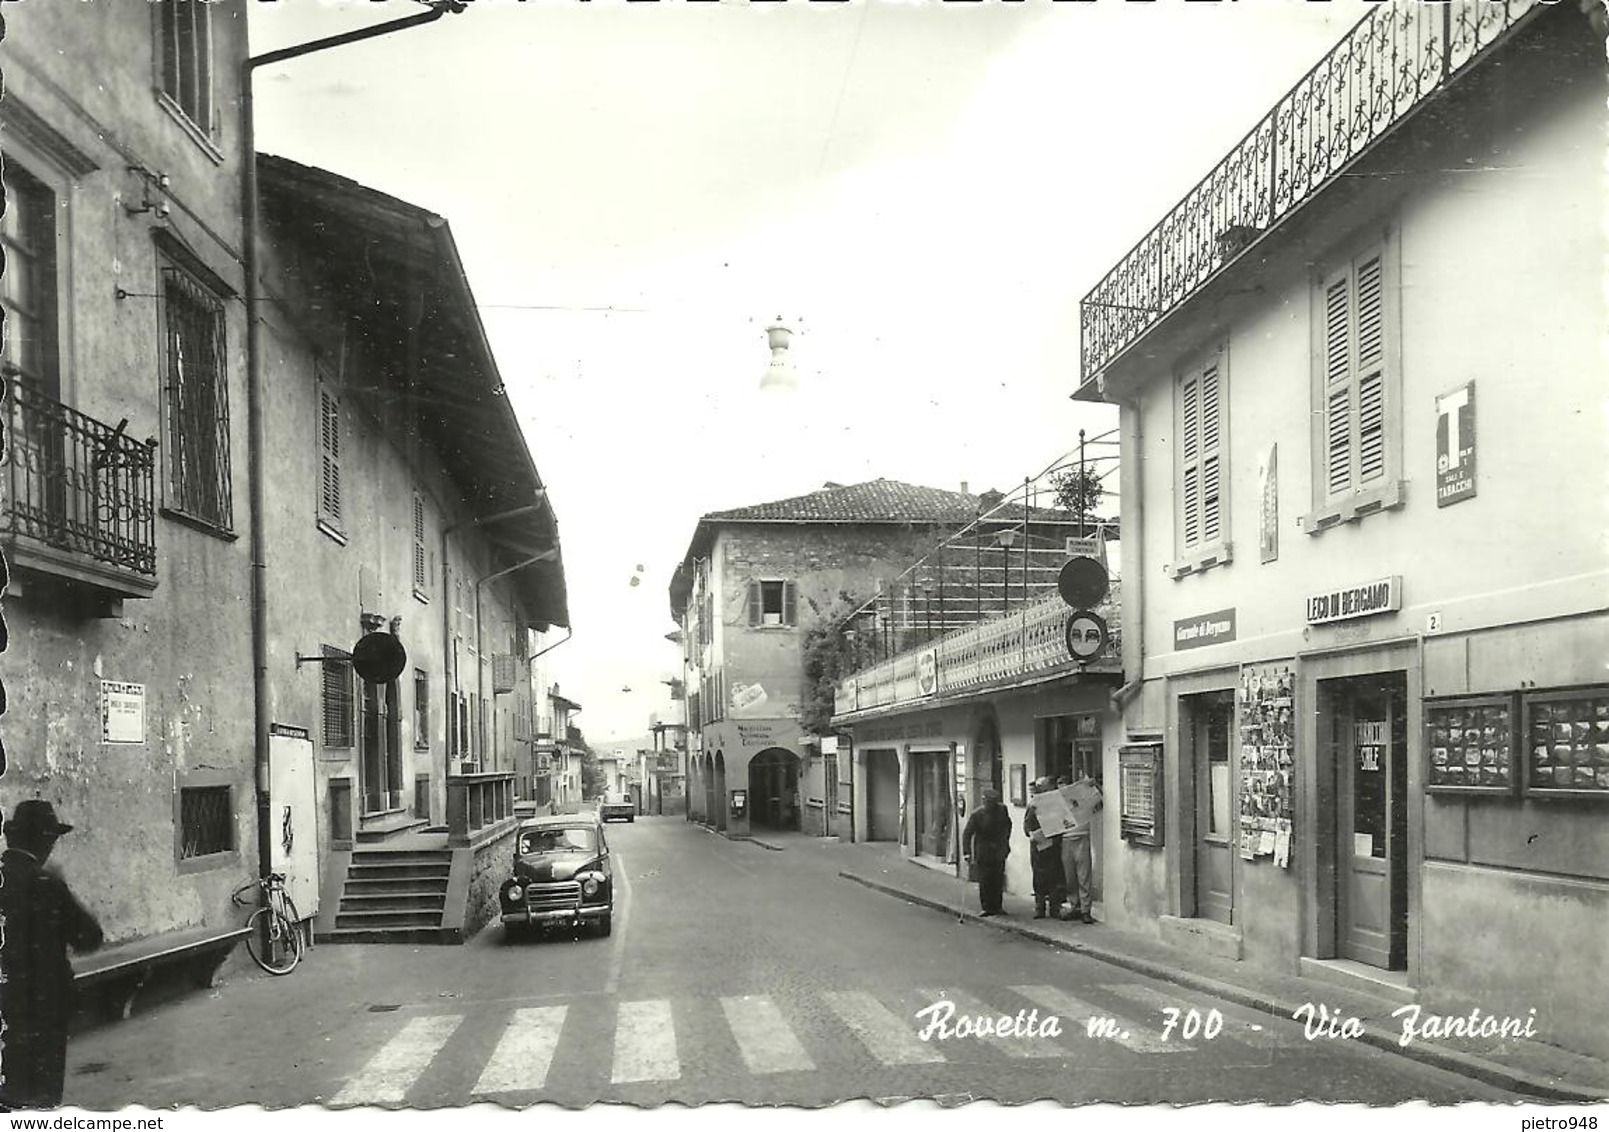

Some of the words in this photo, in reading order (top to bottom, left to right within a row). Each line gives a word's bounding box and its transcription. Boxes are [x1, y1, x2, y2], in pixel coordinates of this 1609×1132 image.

[1439, 388, 1468, 470] T
[1438, 479, 1472, 498] TABACCHI
[1330, 592, 1340, 618] DI
[1341, 582, 1390, 616] BERGAMO
